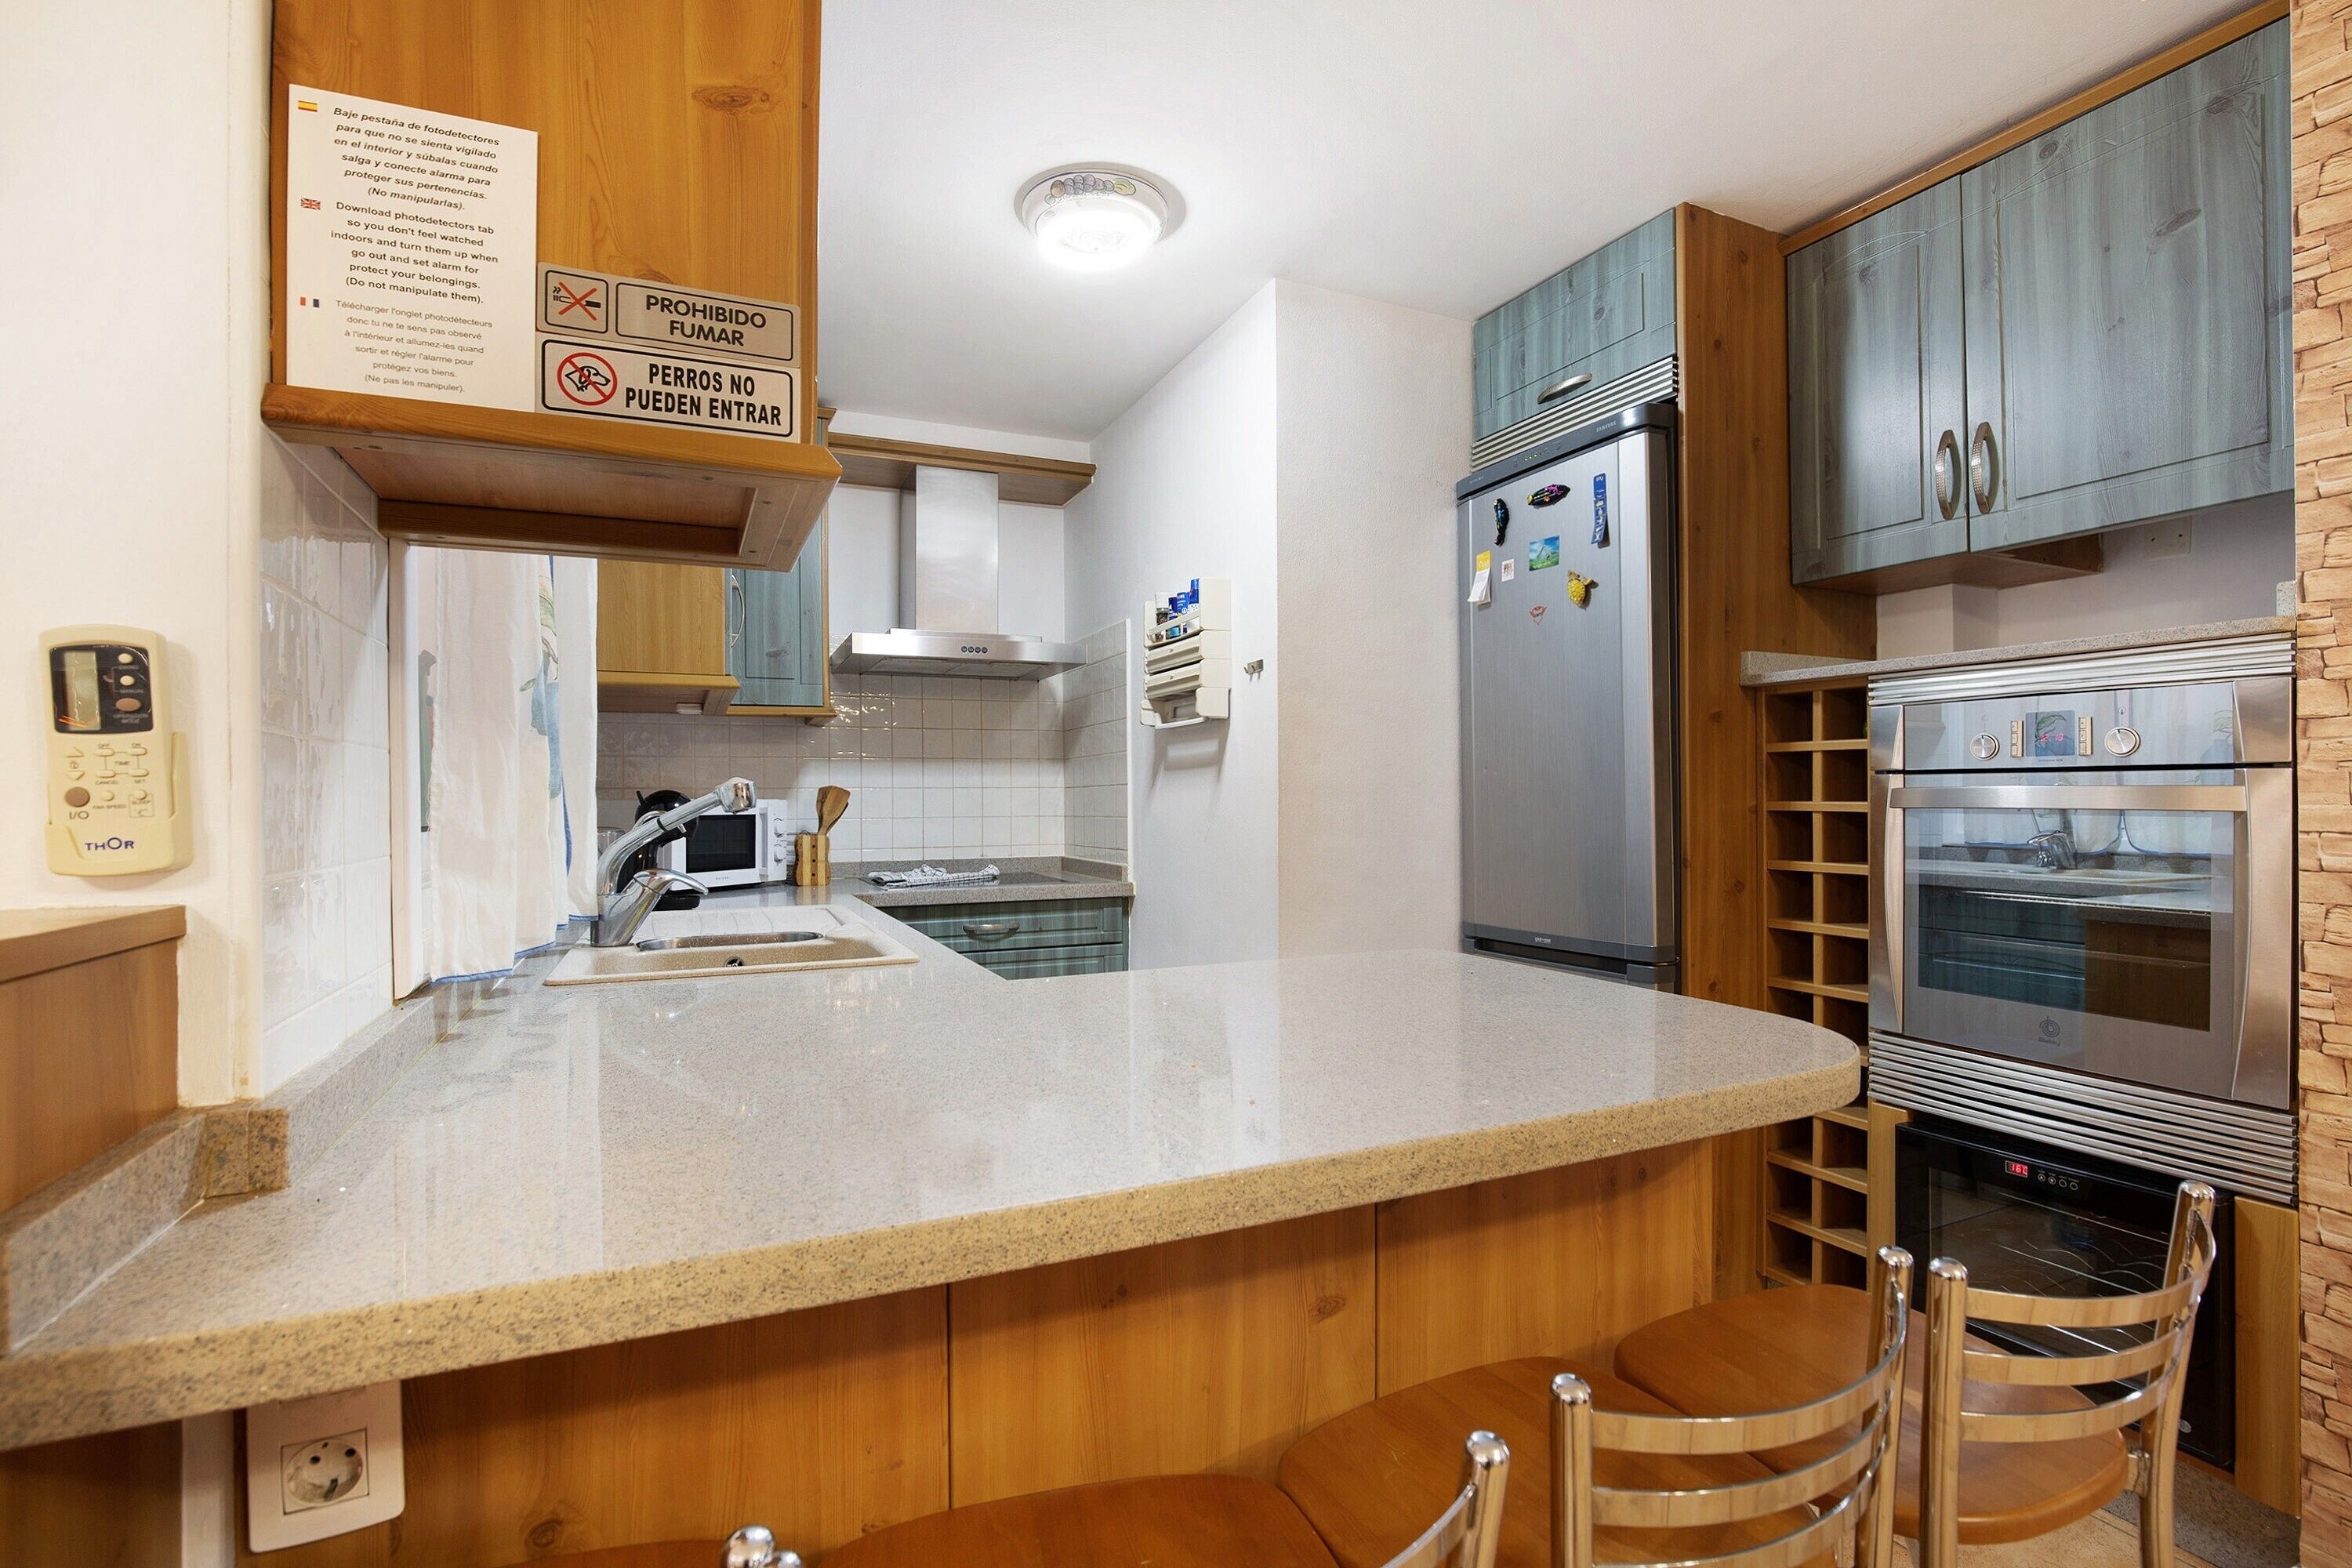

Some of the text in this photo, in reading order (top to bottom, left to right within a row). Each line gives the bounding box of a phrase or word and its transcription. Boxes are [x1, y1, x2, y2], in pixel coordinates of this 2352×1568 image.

[333, 108, 358, 118] Baje
[361, 114, 404, 127] pestaña
[423, 125, 499, 145] fotodetectores
[336, 125, 361, 133] para
[420, 140, 452, 151] sienta
[456, 146, 495, 158] vigilado
[341, 155, 371, 165] salga
[383, 162, 426, 174] conecte
[429, 170, 464, 181] alarma
[467, 177, 490, 186] para
[364, 143, 404, 155] interior
[416, 153, 456, 165] súbalas
[459, 162, 498, 173] cuando
[343, 170, 392, 183] proteger
[416, 183, 487, 199] pertenencias.
[368, 187, 387, 196] (No
[336, 201, 390, 217] Download
[394, 212, 474, 230] photodetectors
[331, 230, 372, 244] indoors
[400, 241, 421, 251] turn
[425, 245, 451, 256] them
[470, 253, 498, 263] when
[387, 225, 414, 236] don't
[417, 230, 436, 238] feel
[439, 234, 483, 246] watched
[350, 264, 387, 275] protect
[419, 273, 480, 289] belongings.
[432, 261, 461, 271] alarm
[464, 265, 479, 274] for
[346, 277, 365, 286] (Do
[389, 285, 448, 298] manipulate
[451, 292, 483, 304] them).
[645, 294, 766, 328] PROHIBIDO
[670, 320, 744, 347] FUMAR
[431, 368, 457, 377] biens.
[649, 363, 755, 397] PERROS NO
[626, 387, 781, 426] PUEDEN ENTRAR
[85, 837, 135, 851] THOR
